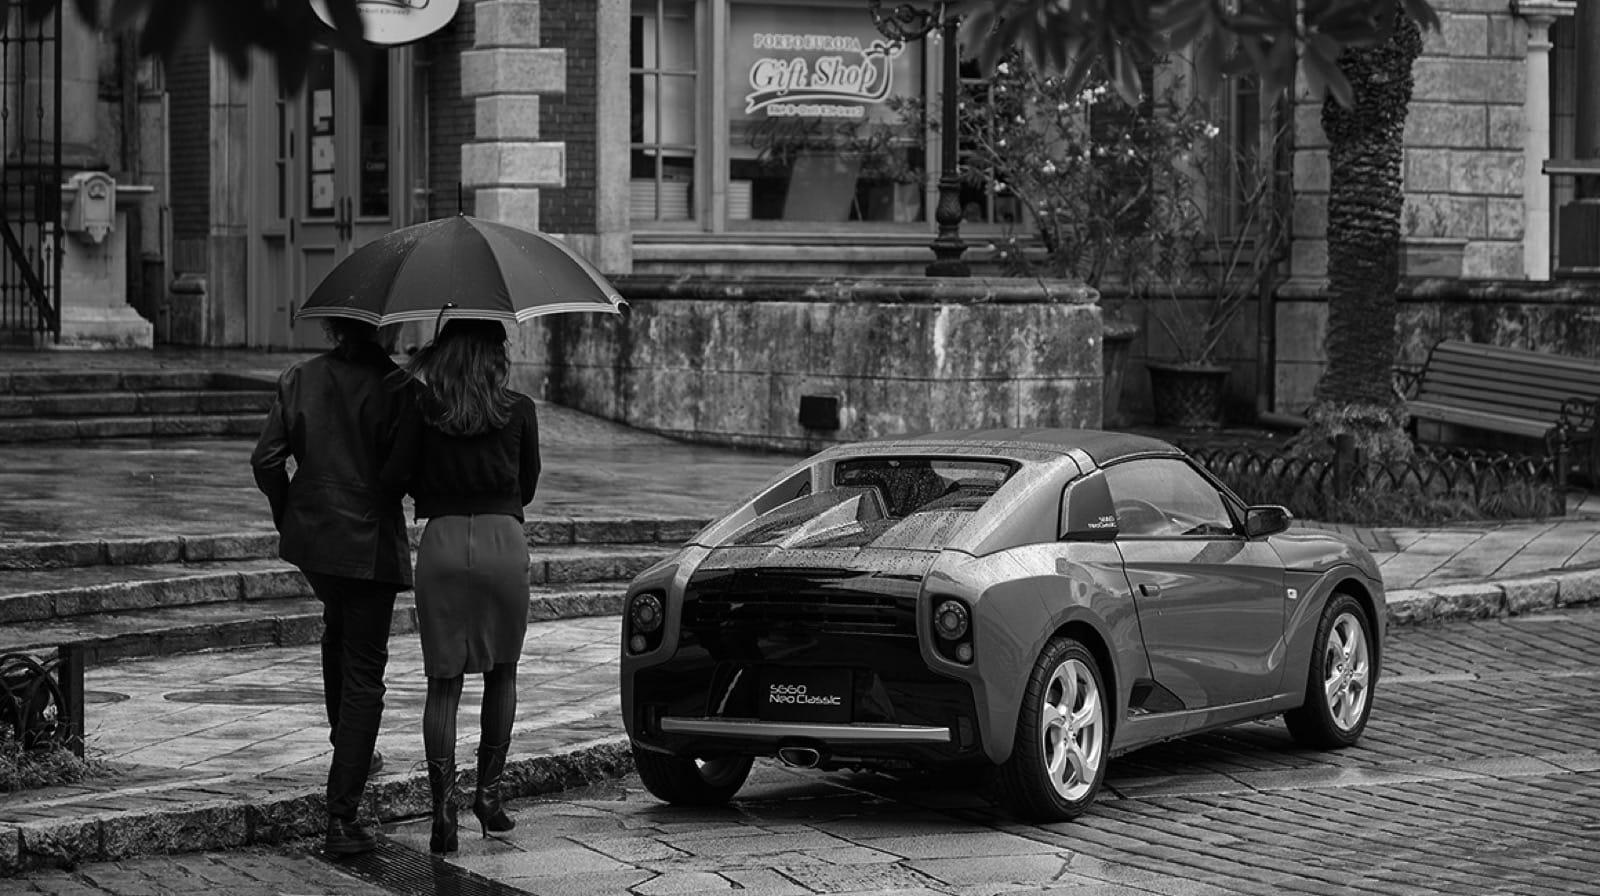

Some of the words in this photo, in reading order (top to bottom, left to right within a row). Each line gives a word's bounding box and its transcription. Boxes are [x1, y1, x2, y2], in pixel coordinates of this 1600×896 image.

[751, 58, 807, 95] Gift
[812, 56, 877, 93] Shop
[769, 694, 795, 704] Neo
[796, 694, 841, 705] Classic
